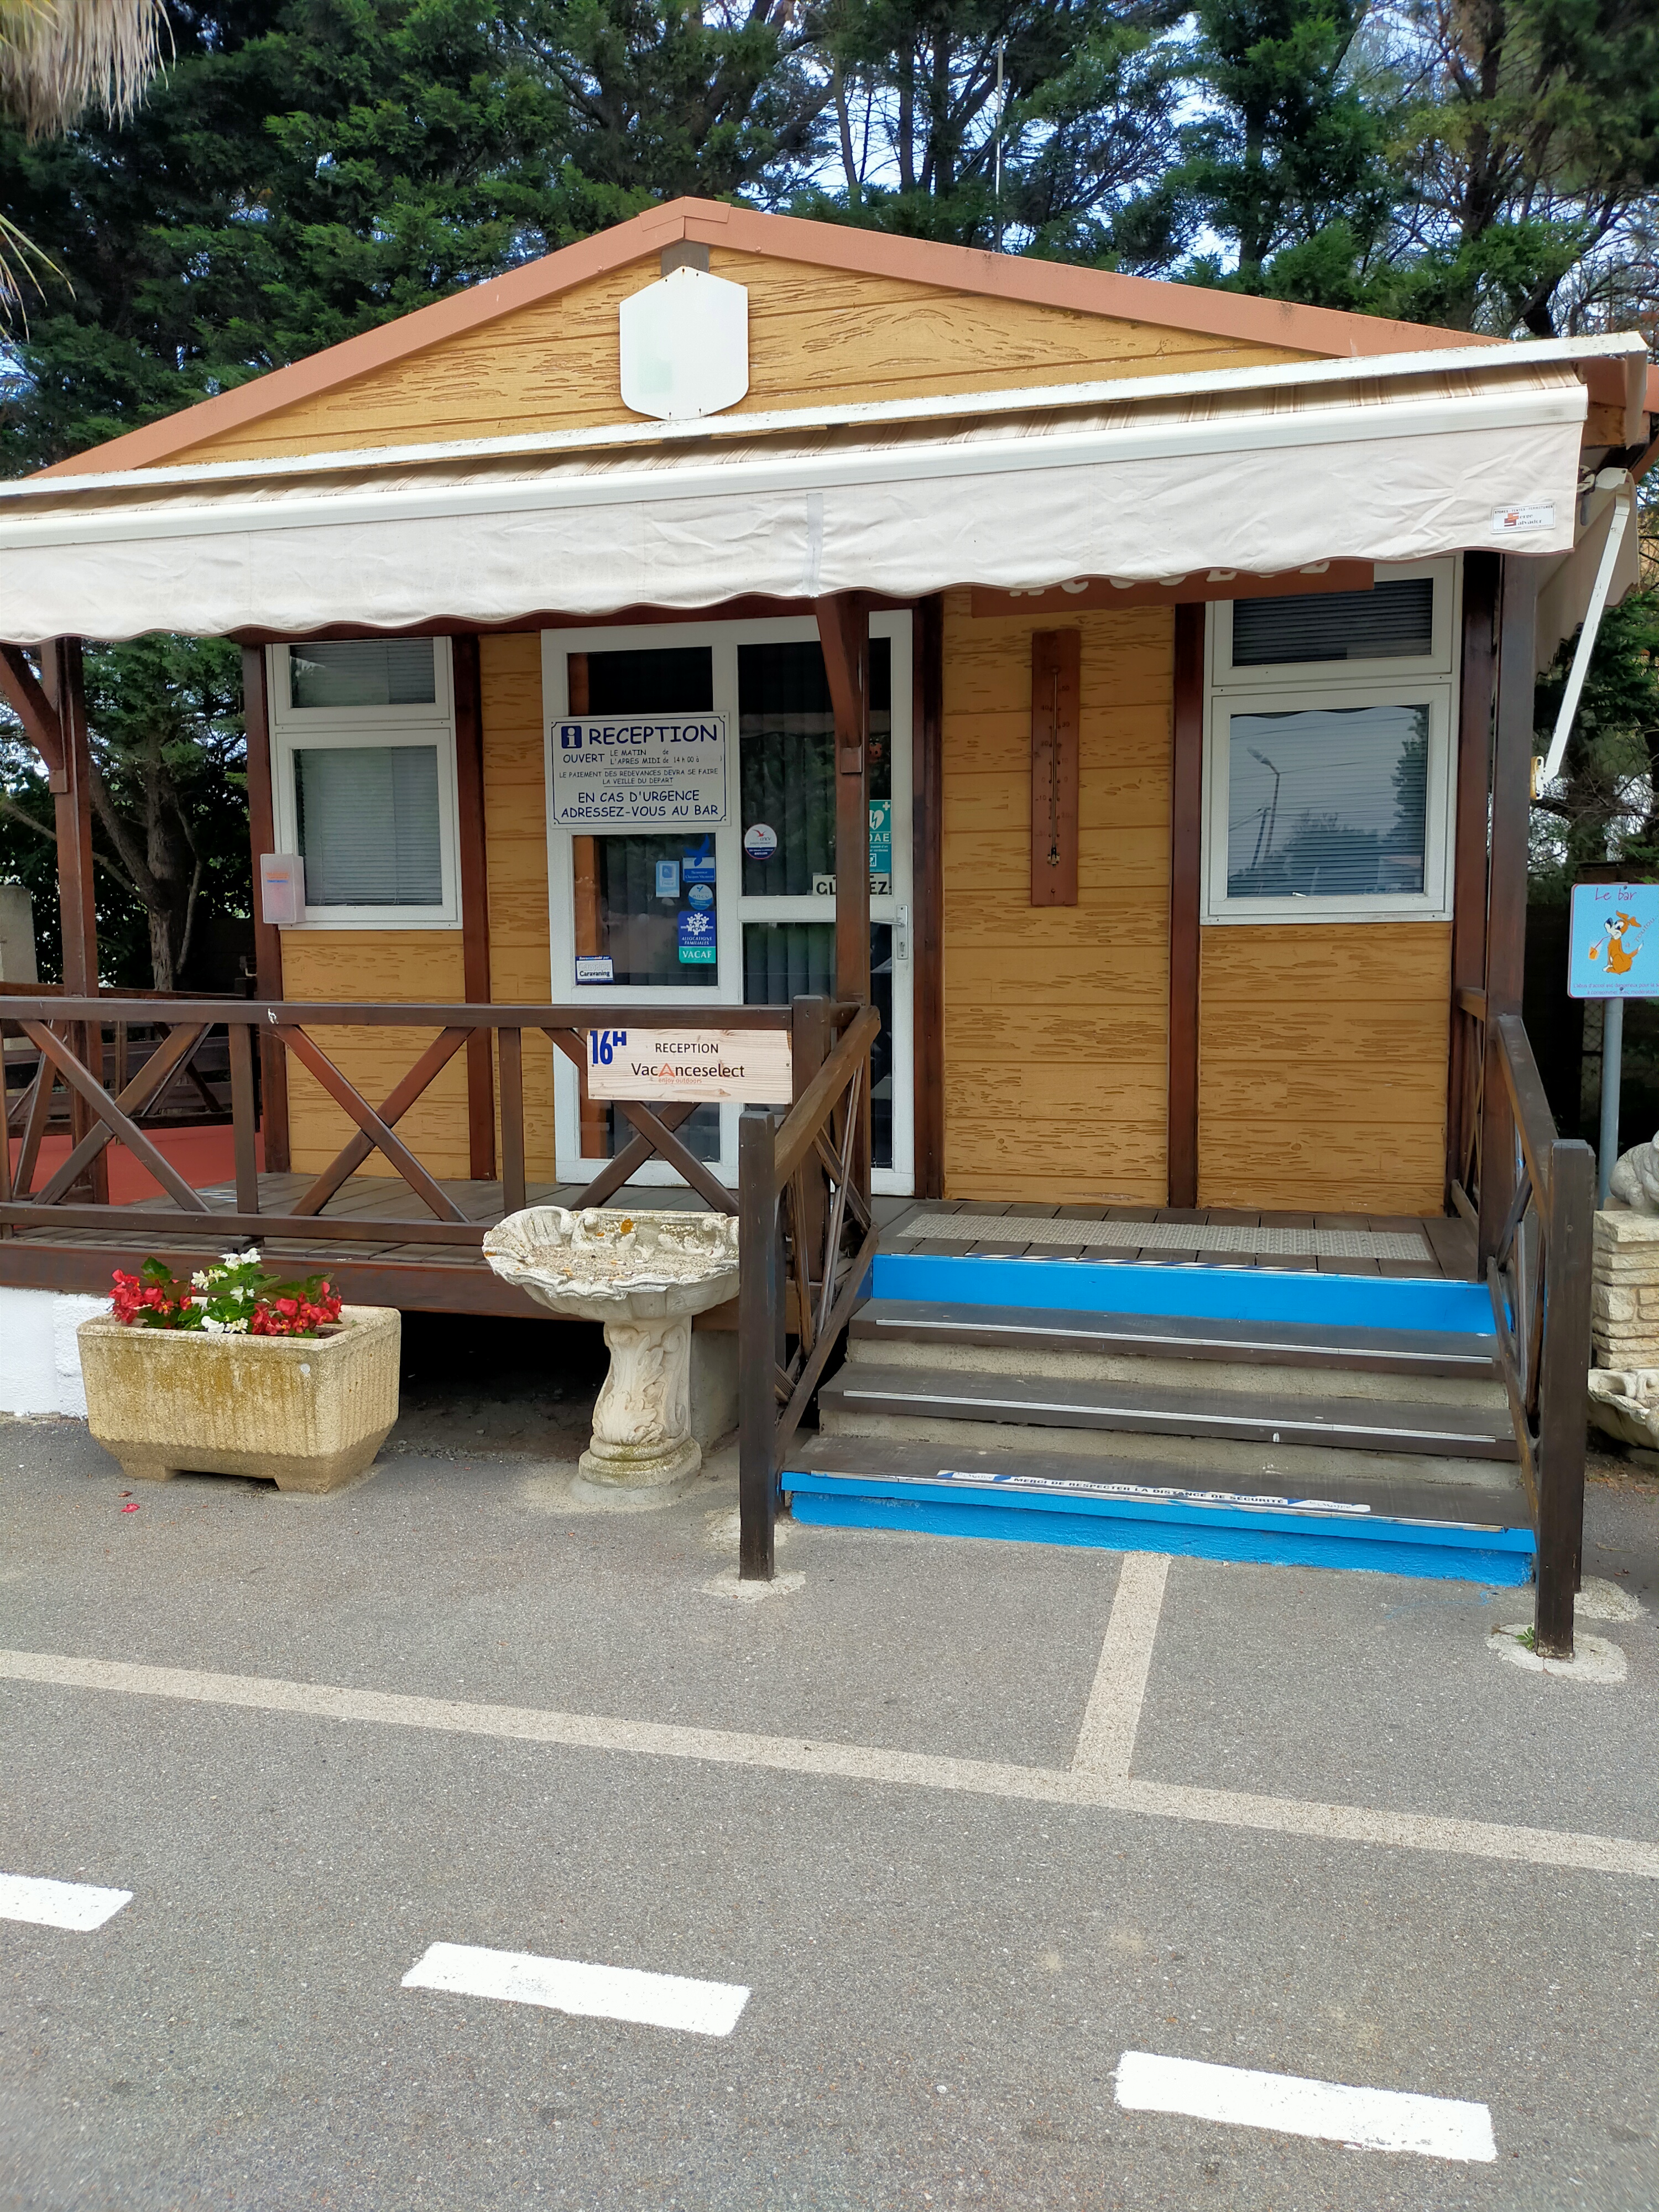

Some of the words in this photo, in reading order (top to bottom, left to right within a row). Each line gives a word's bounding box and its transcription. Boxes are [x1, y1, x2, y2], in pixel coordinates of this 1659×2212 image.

[589, 724, 717, 745] RECEPTION
[563, 753, 604, 763] OUVERT
[578, 792, 594, 803] EN
[600, 792, 624, 802] CAS
[630, 790, 700, 802] D'URGENCE
[561, 806, 666, 817] ADRESSEZ-VOUS
[672, 805, 688, 816] AU
[695, 805, 718, 815] BAR
[1595, 887, 1611, 900] Le
[1618, 888, 1637, 901] bar
[655, 1043, 718, 1053] RECEPTION
[1068, 1483, 1130, 1491] RESPECTER
[1153, 1489, 1206, 1498] DISTANCE
